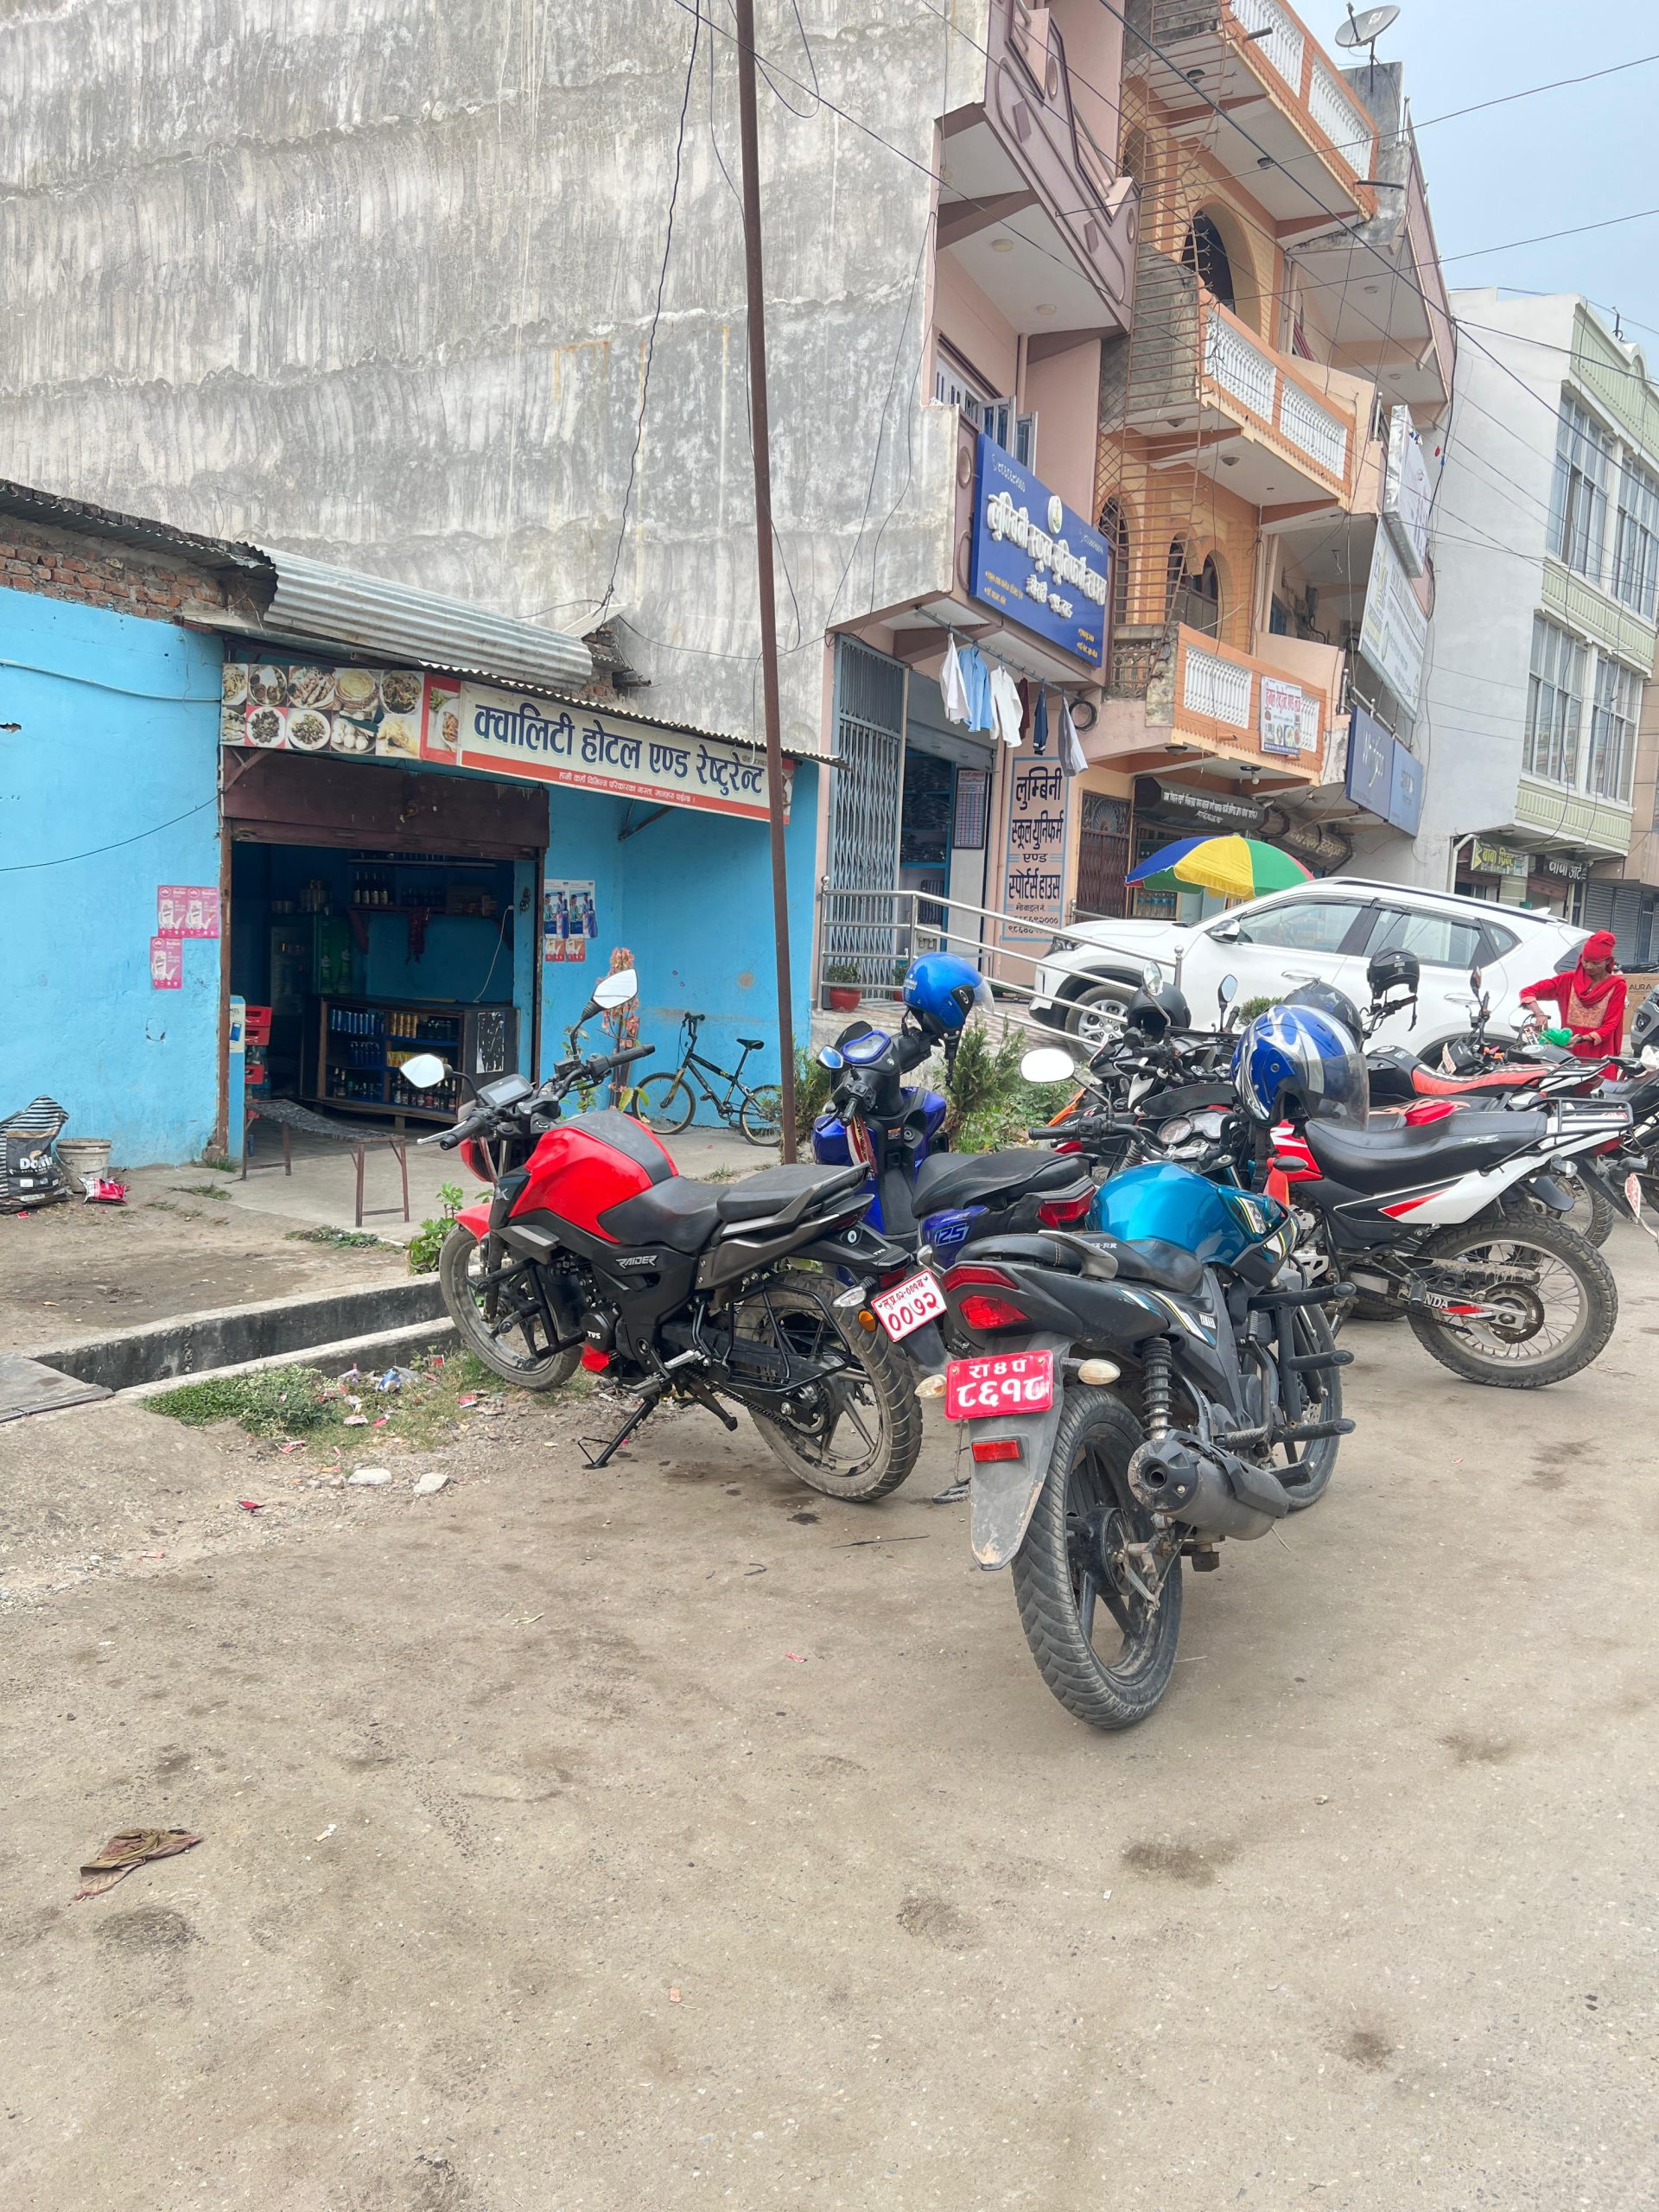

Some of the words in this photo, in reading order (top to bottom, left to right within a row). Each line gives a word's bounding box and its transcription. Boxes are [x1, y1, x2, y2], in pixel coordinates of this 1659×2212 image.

[474, 702, 575, 756] क्वालिटी
[582, 720, 642, 770] होटल
[649, 742, 690, 779] एण्ड
[1015, 766, 1062, 810] लुम्बिनी
[1033, 810, 1064, 849] युनिफर्म
[1023, 853, 1048, 863] एण्ड
[1039, 874, 1061, 899] हाउस
[935, 1223, 969, 1247] 125
[615, 1255, 658, 1269] RAIDER
[888, 1292, 937, 1332] ००७२
[588, 1330, 601, 1339] TVS
[969, 1364, 989, 1379] रा
[994, 1363, 1007, 1375] ४
[1012, 1359, 1027, 1374] प
[956, 1376, 1051, 1408] ८६१८
